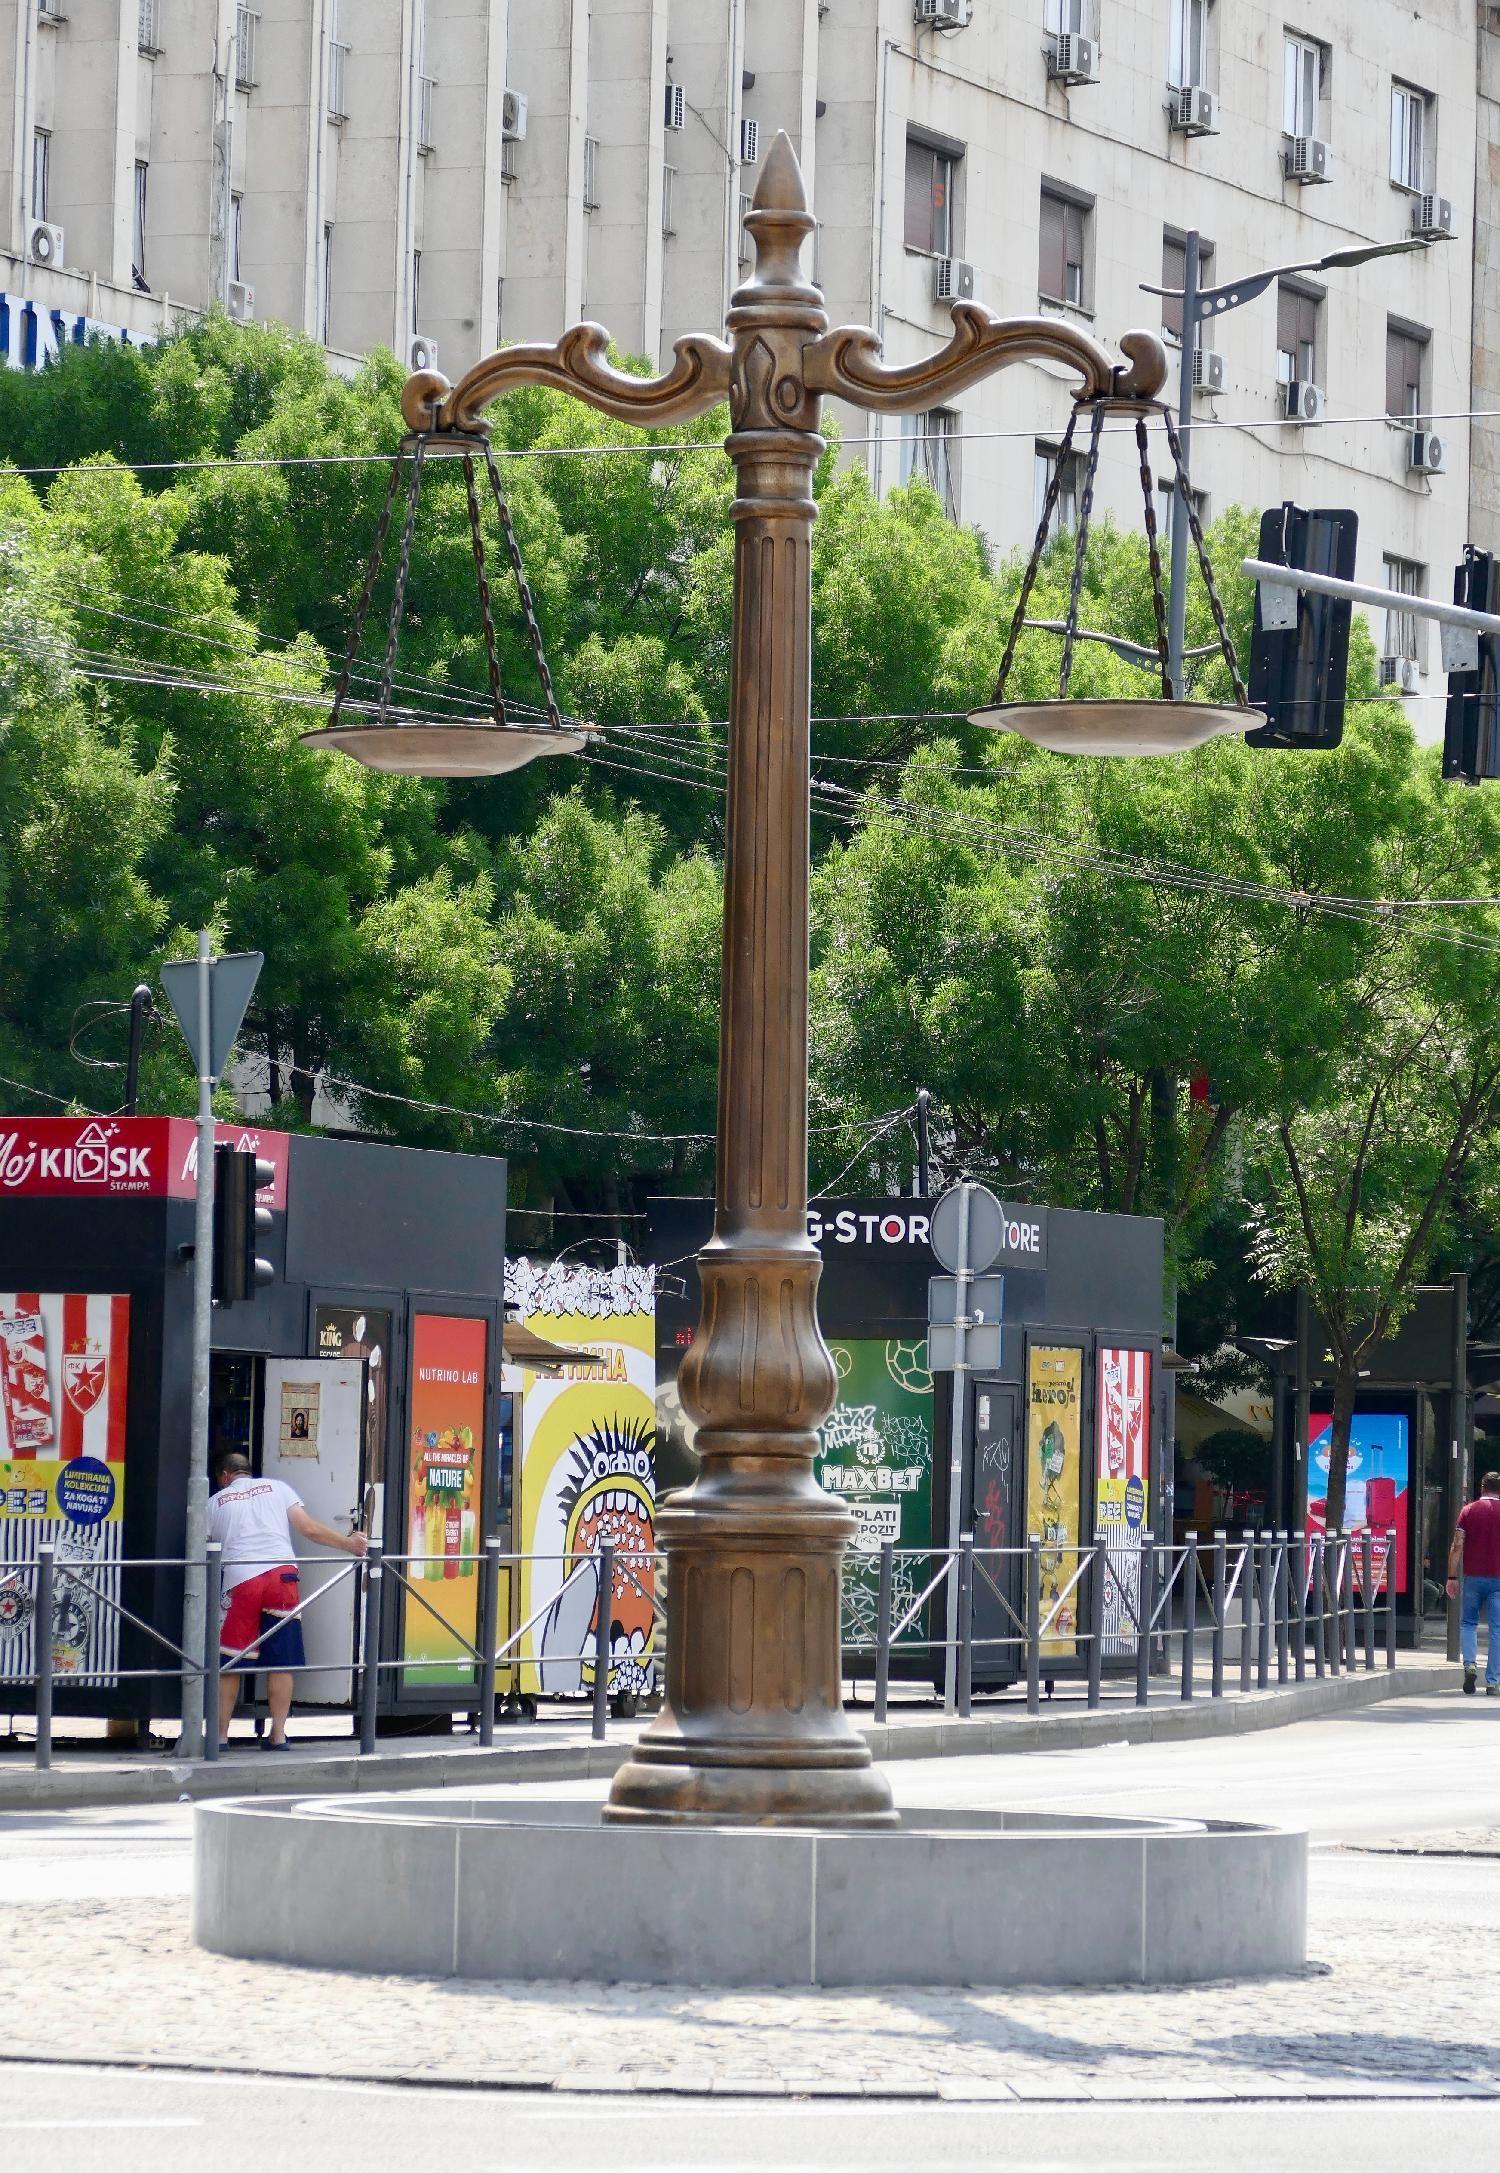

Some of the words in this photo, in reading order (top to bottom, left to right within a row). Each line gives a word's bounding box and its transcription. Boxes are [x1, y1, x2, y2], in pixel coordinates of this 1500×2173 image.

[109, 1180, 150, 1191] ŠTAMPA
[806, 1210, 931, 1244] G-STOR
[319, 1330, 342, 1347] KING
[419, 1367, 459, 1383] NUTRINO
[462, 1371, 478, 1384] LAB
[64, 1470, 110, 1484] LIMITIRANA
[429, 1468, 462, 1488] NATURE
[822, 1465, 924, 1492] MAXBET
[63, 1491, 75, 1501] ZA
[76, 1493, 98, 1505] KOGA
[99, 1497, 107, 1505] TI
[857, 1524, 896, 1534] POZIT
